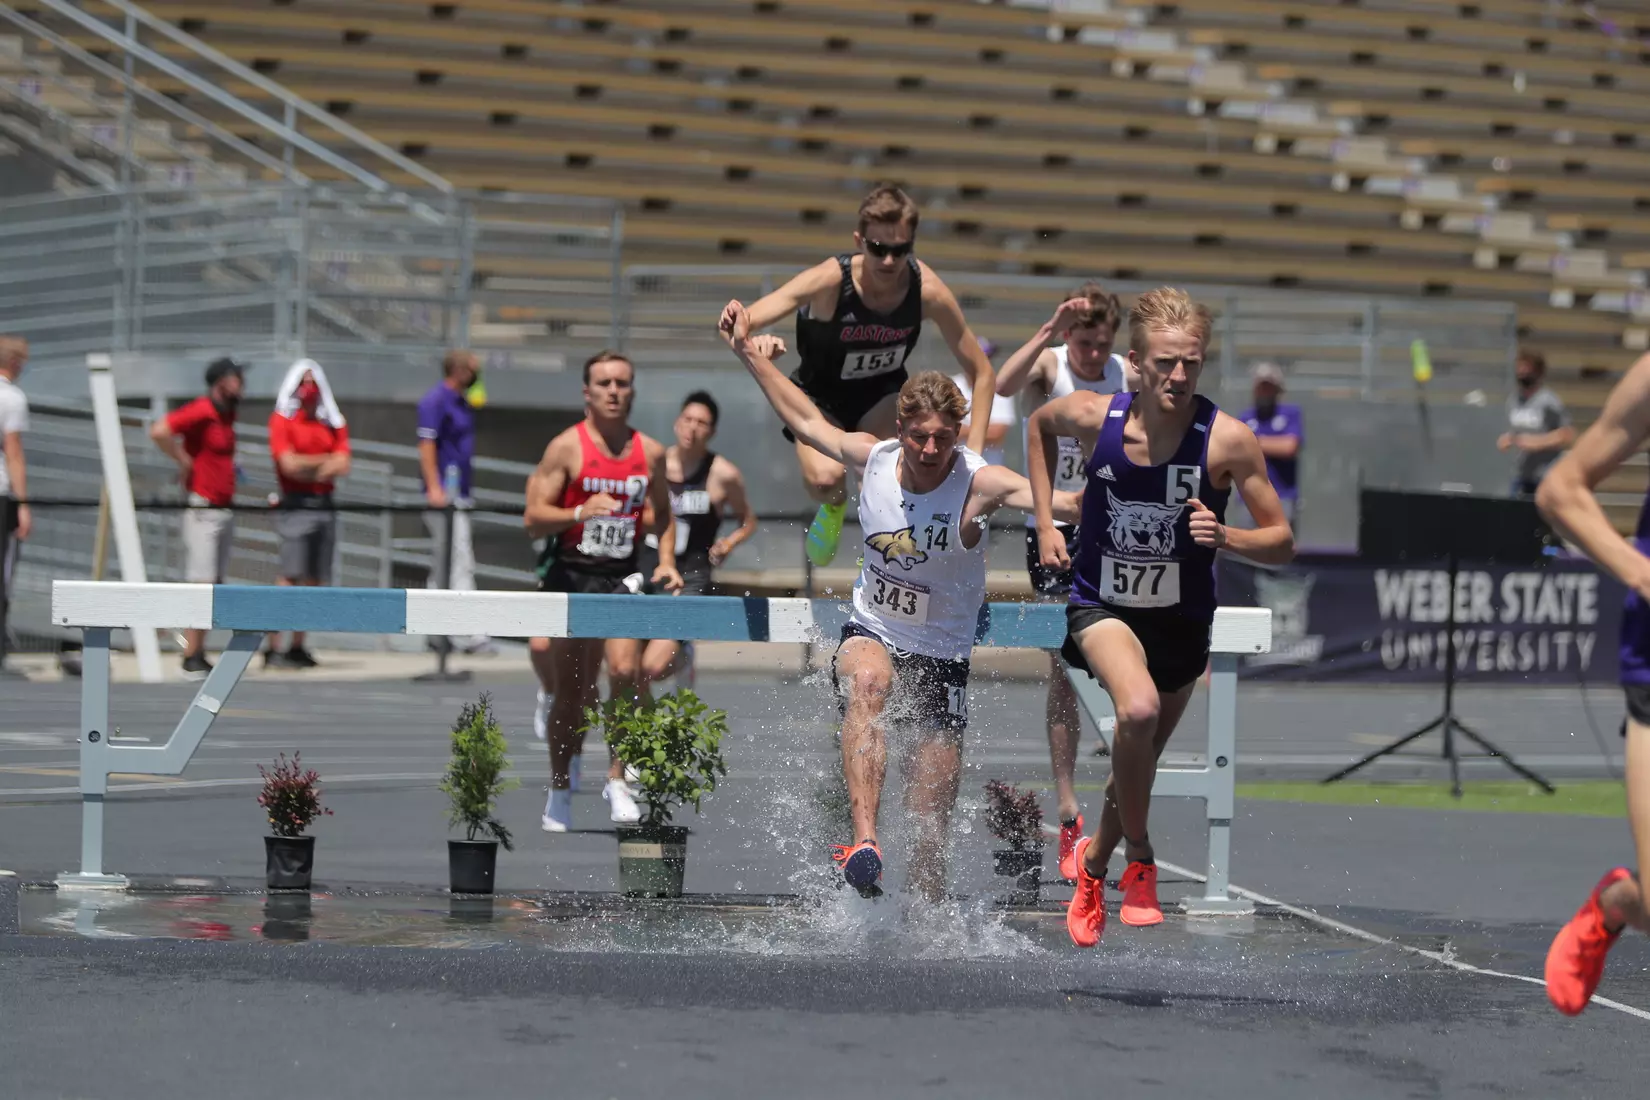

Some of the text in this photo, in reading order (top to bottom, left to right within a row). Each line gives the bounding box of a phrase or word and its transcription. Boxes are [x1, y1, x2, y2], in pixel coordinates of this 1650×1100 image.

[853, 351, 896, 372] 153
[631, 479, 643, 503] 2
[1174, 467, 1194, 505] 5
[924, 525, 949, 551] 14
[873, 578, 918, 616] 343
[1113, 562, 1167, 596] 577
[1374, 569, 1599, 625] WEBER STATE
[1380, 628, 1597, 671] UNIVERSITY
